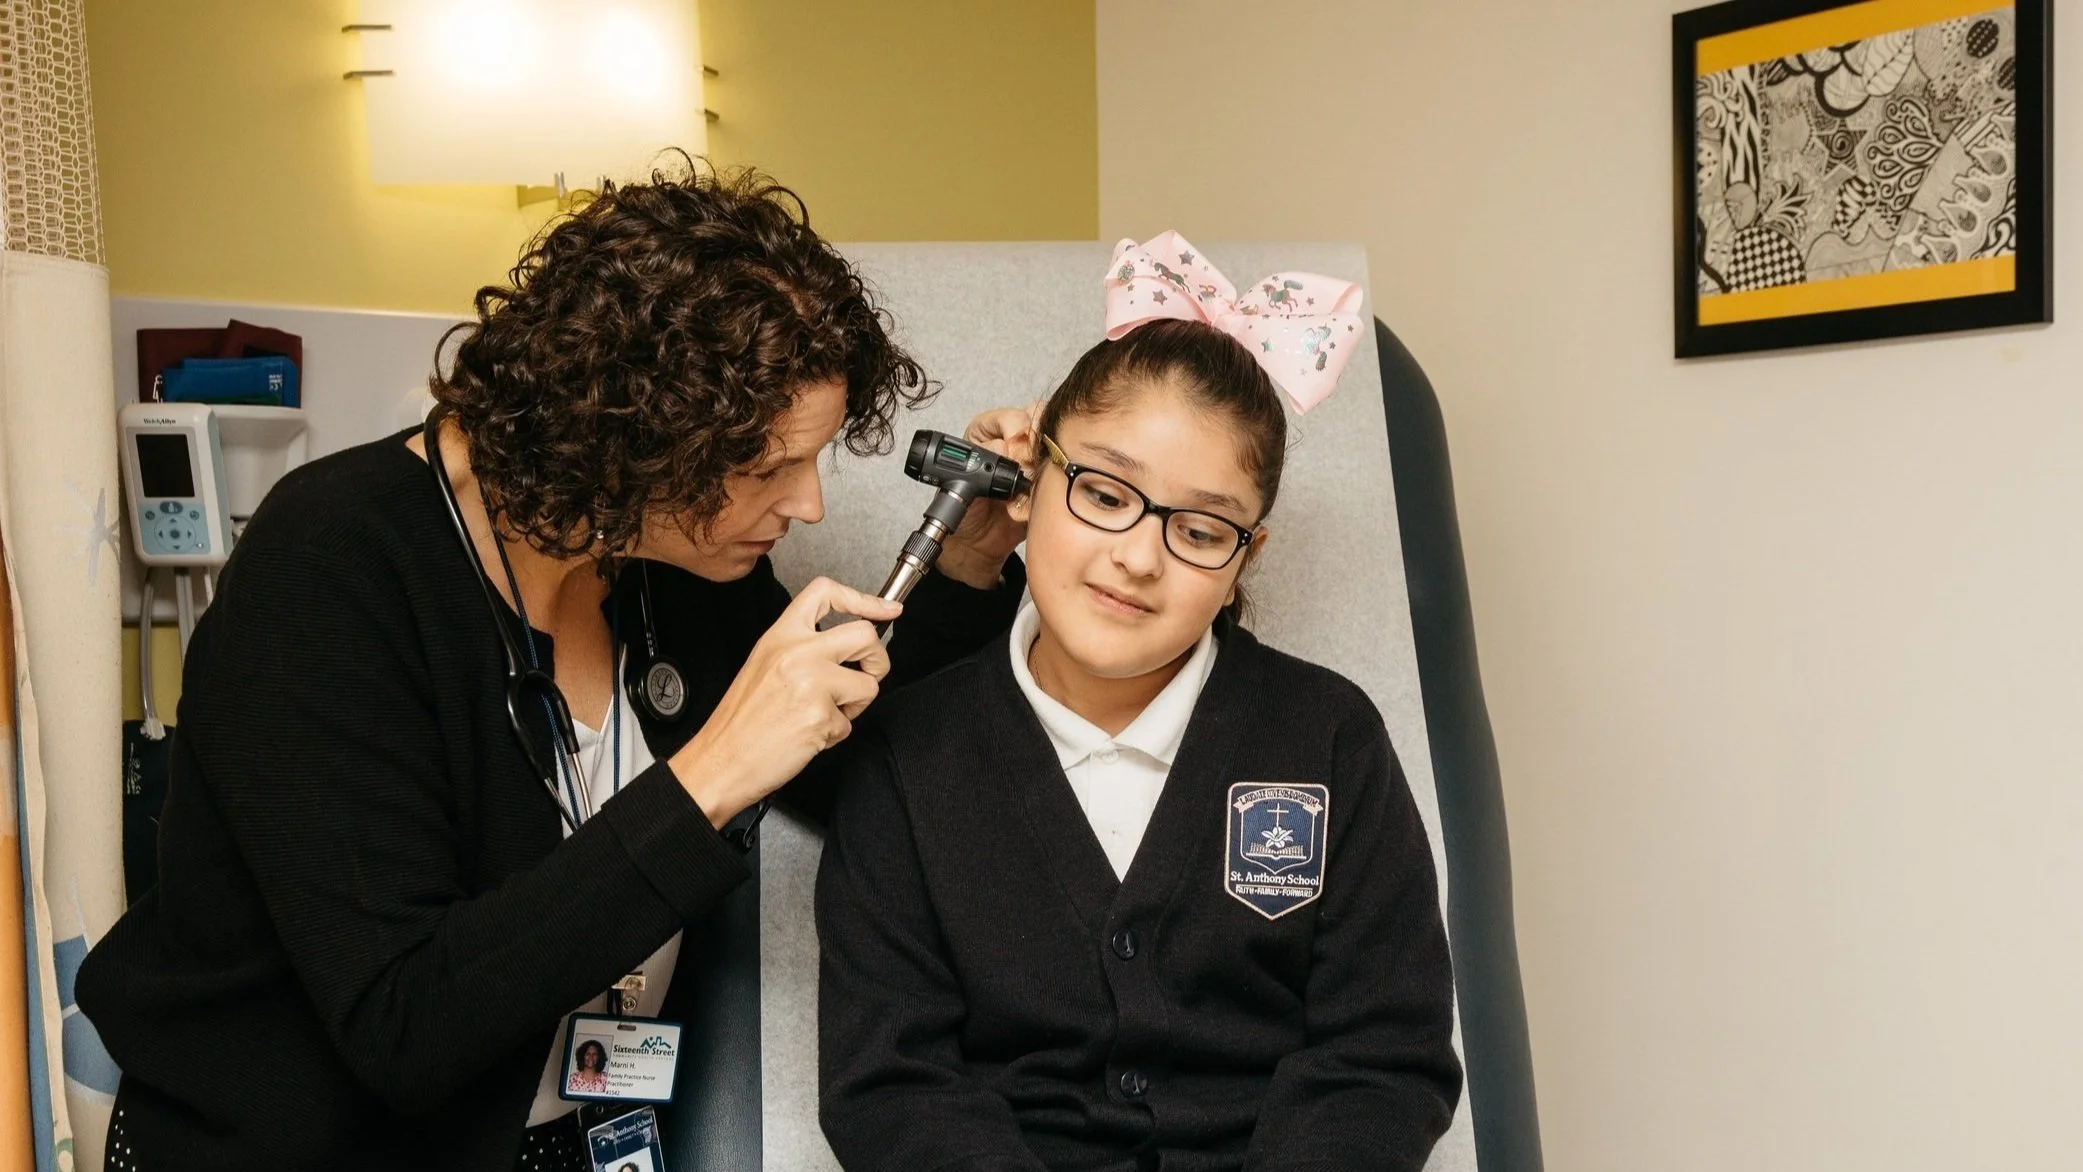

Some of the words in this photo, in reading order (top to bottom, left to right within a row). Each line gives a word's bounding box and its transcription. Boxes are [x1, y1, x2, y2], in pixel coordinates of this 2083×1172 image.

[1230, 871, 1244, 882] St.
[1245, 871, 1286, 886] Anthony
[1287, 873, 1319, 886] School
[613, 1044, 650, 1055] Sixteenth
[651, 1047, 675, 1057] Street
[611, 1061, 628, 1069] Marni
[637, 1115, 653, 1128] School
